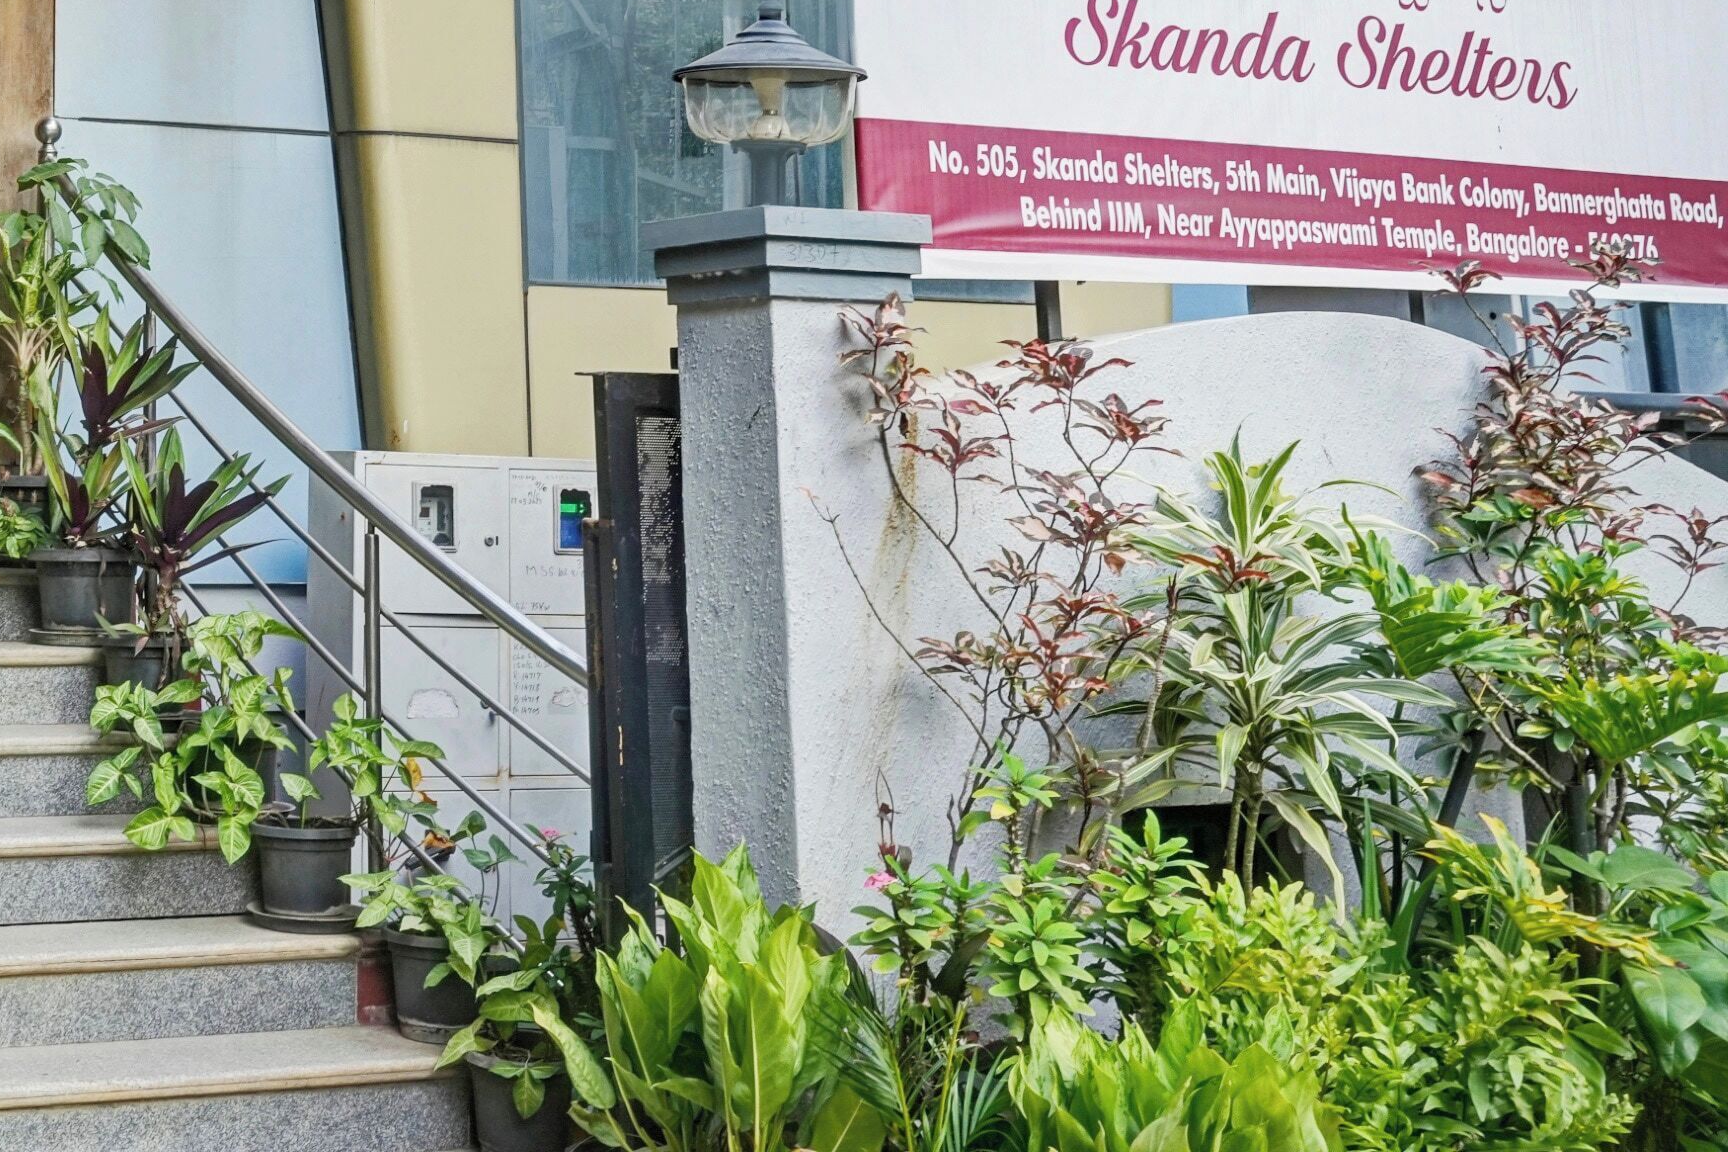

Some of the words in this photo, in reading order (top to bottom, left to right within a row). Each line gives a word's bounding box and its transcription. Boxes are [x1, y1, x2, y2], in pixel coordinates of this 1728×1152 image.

[1336, 15, 1578, 111] Shelters
[928, 139, 970, 175] No.
[976, 143, 1027, 184] 505,
[1032, 145, 1119, 185] Skanda
[1124, 152, 1220, 196] Shelters,
[1225, 159, 1261, 193] 5th
[1266, 162, 1327, 202] Main,
[1330, 167, 1397, 209] Vijaya
[1401, 172, 1456, 205] Bank
[1459, 176, 1530, 218] Colony,
[1533, 182, 1666, 225] Bannerghatta
[1670, 193, 1724, 229] Road,
[1020, 195, 1102, 236] Behind
[1107, 200, 1152, 240] IIM,
[1157, 202, 1213, 237] Near
[1219, 207, 1377, 250] Ayyappaswami
[1381, 217, 1462, 258] Temple,
[1466, 222, 1569, 262] Bangalore
